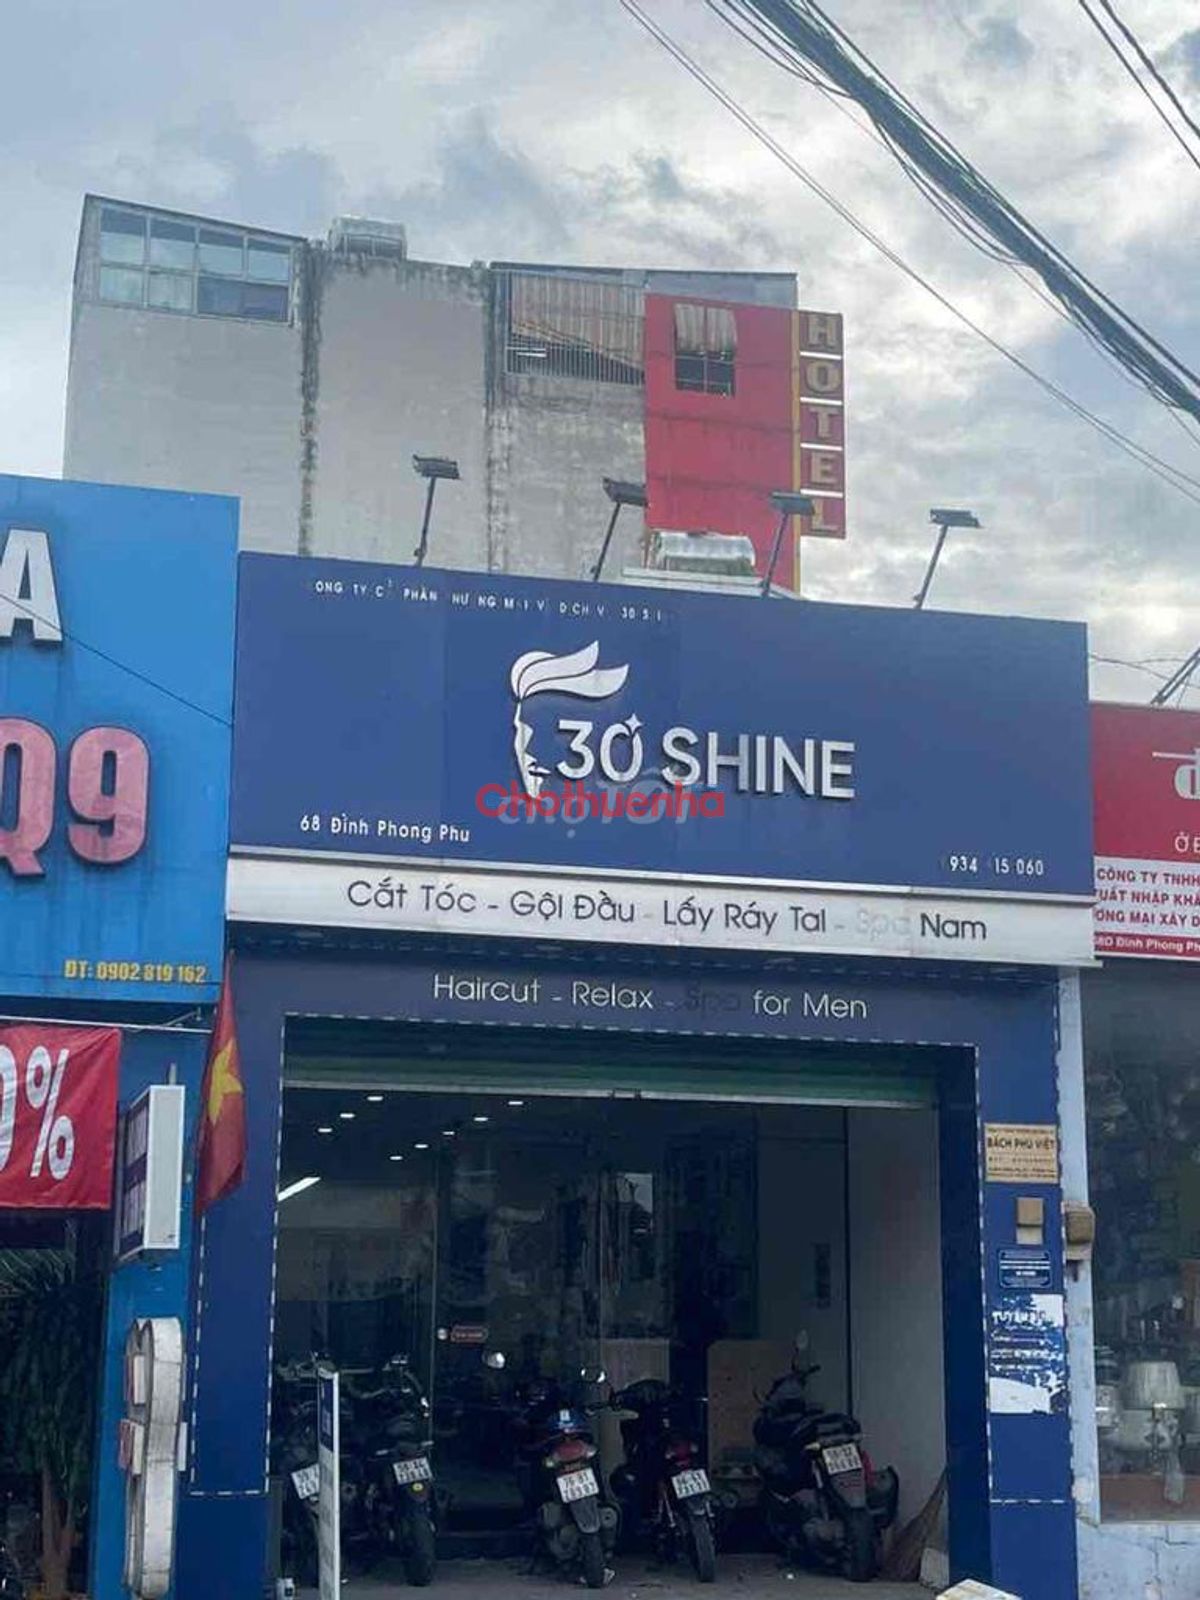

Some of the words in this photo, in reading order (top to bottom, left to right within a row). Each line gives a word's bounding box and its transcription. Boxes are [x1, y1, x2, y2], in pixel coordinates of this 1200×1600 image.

[805, 313, 840, 532] HOTEL
[558, 713, 643, 783] 30
[661, 726, 856, 800] SHINE
[300, 815, 320, 832] 68
[377, 819, 432, 844] Phong
[1016, 858, 1044, 876] 060
[1097, 866, 1136, 883] CÔNG
[1140, 871, 1158, 884] TY
[1163, 873, 1200, 887] TNHH
[347, 876, 408, 909] Cắt
[421, 883, 477, 912] Tóc
[574, 890, 634, 922] Đầu
[664, 896, 714, 932] Lấy
[724, 901, 778, 936] Ráy
[920, 912, 987, 940] Nam
[1129, 911, 1155, 927] MẠI
[97, 961, 140, 981] 0902
[143, 963, 173, 982] 819
[178, 965, 206, 983] 162
[434, 974, 541, 1003] Haircut
[573, 981, 653, 1008] Relax
[753, 989, 791, 1016] for
[804, 992, 867, 1018] Men
